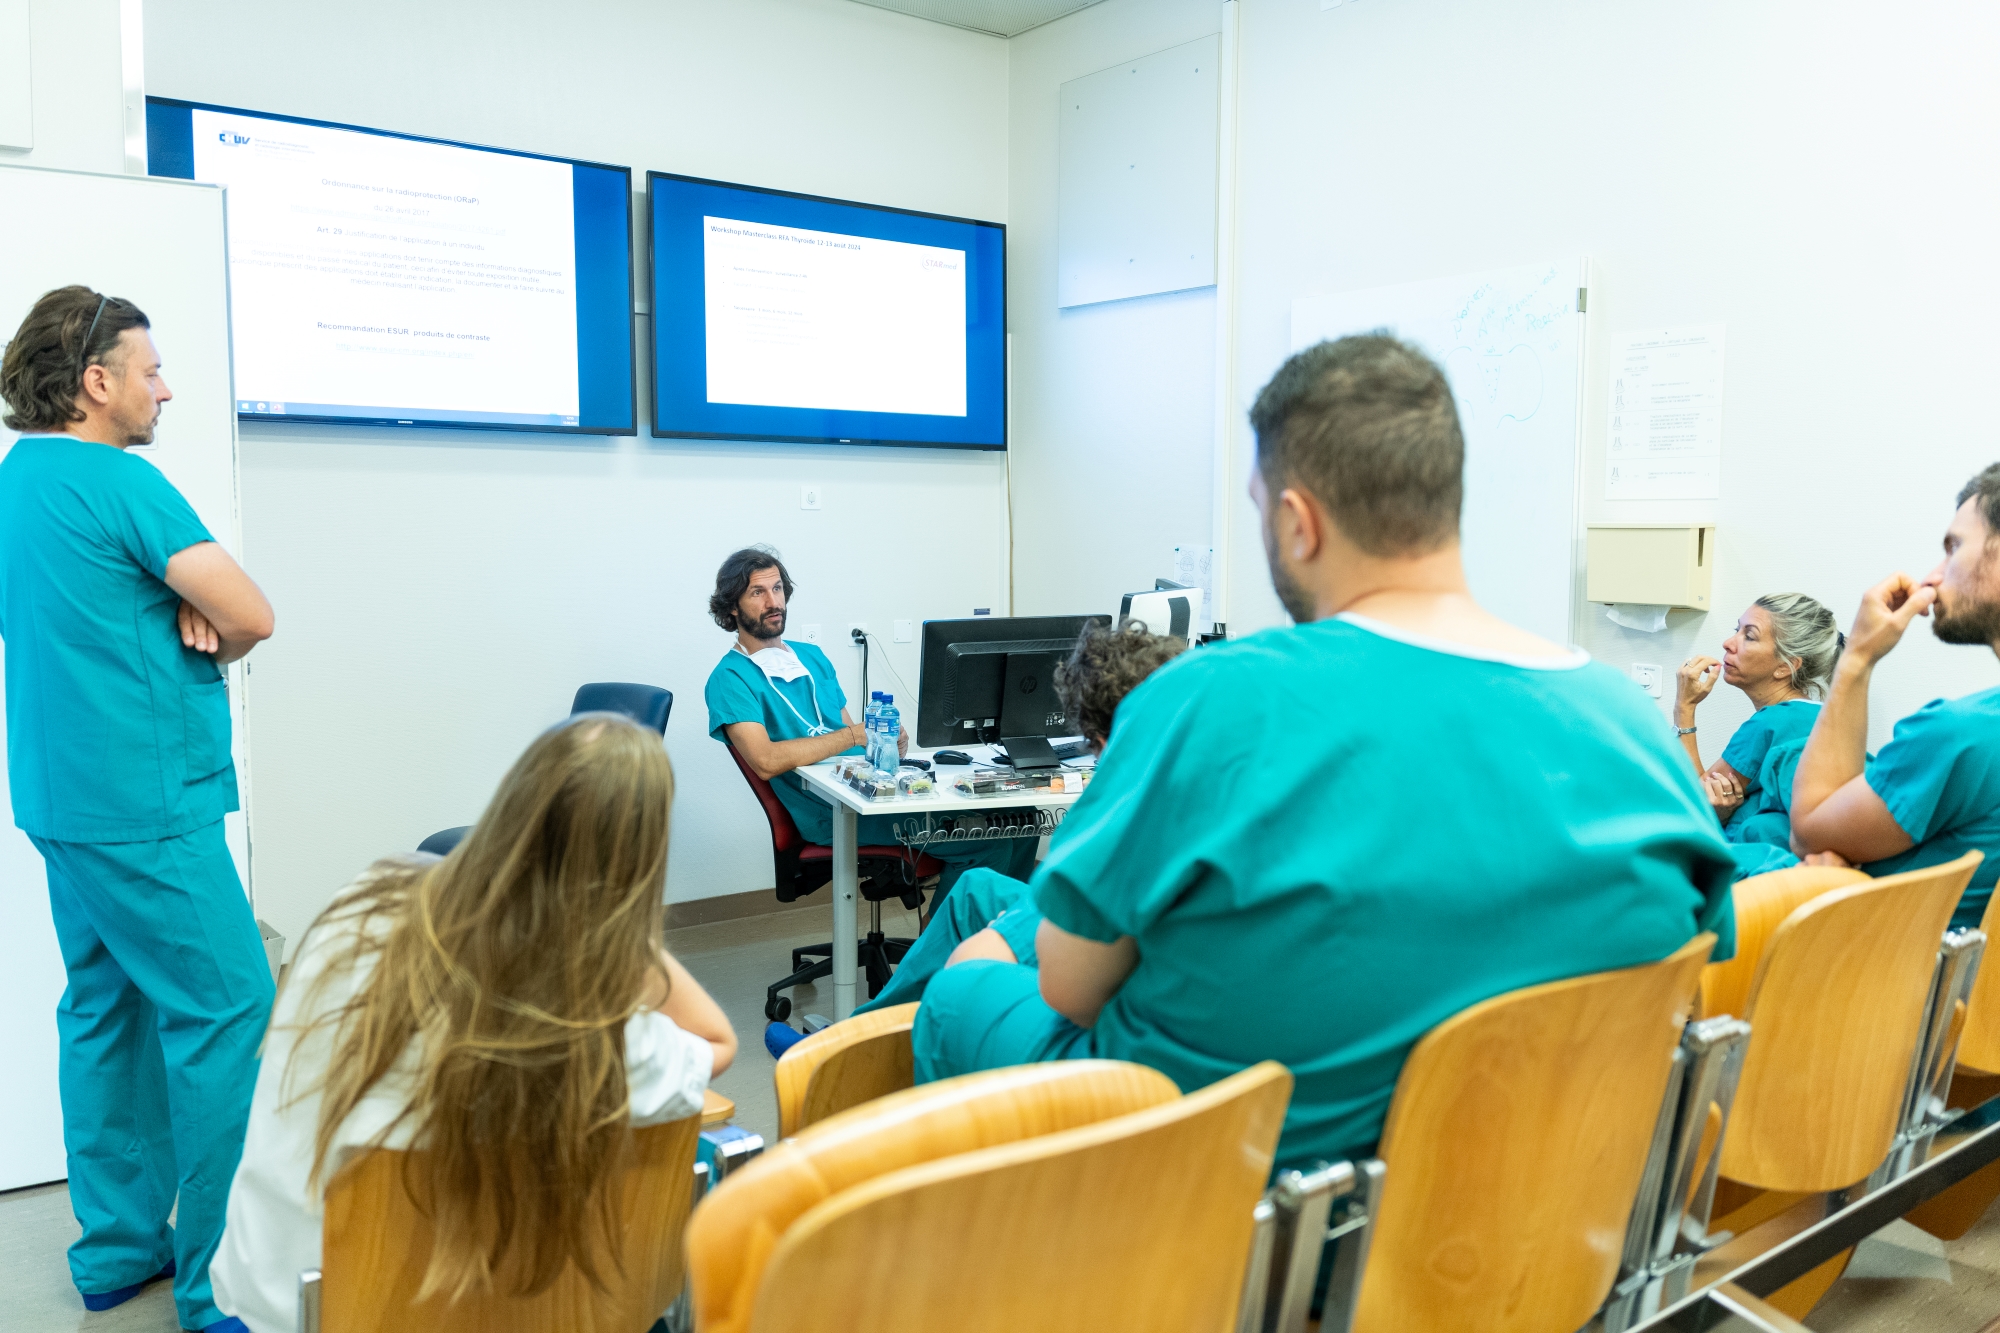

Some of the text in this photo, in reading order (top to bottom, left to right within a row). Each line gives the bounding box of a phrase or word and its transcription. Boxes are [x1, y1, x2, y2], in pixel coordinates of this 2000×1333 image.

[219, 133, 251, 145] CHUV
[322, 178, 370, 191] Ordonnance
[372, 185, 384, 193] sur
[395, 188, 452, 202] radioprotection
[454, 195, 480, 206] (ORaP)
[396, 206, 411, 215] avril
[413, 208, 430, 217] 2017
[317, 226, 330, 234] Art.
[345, 229, 388, 240] Justification
[459, 242, 485, 251] individu
[711, 225, 742, 236] Workshop
[743, 230, 777, 240] Masterclass
[817, 239, 833, 247] 12-13
[230, 256, 272, 268] Quiconque
[274, 261, 302, 270] prescrit
[320, 265, 364, 276] applications
[380, 271, 402, 279] établir
[464, 279, 503, 289] documenter
[251, 249, 295, 260] disponibles
[318, 255, 340, 264] passé
[342, 257, 370, 266] médical
[486, 272, 519, 282] exposition
[359, 250, 402, 261] applications
[435, 258, 461, 267] compte
[476, 262, 516, 272] informations
[518, 266, 562, 277] diagnostiques
[926, 259, 958, 270] STARmed
[351, 278, 382, 287] médecin
[383, 281, 413, 290] réalisant
[317, 321, 491, 341] Recommandation ESUR produits de contraste
